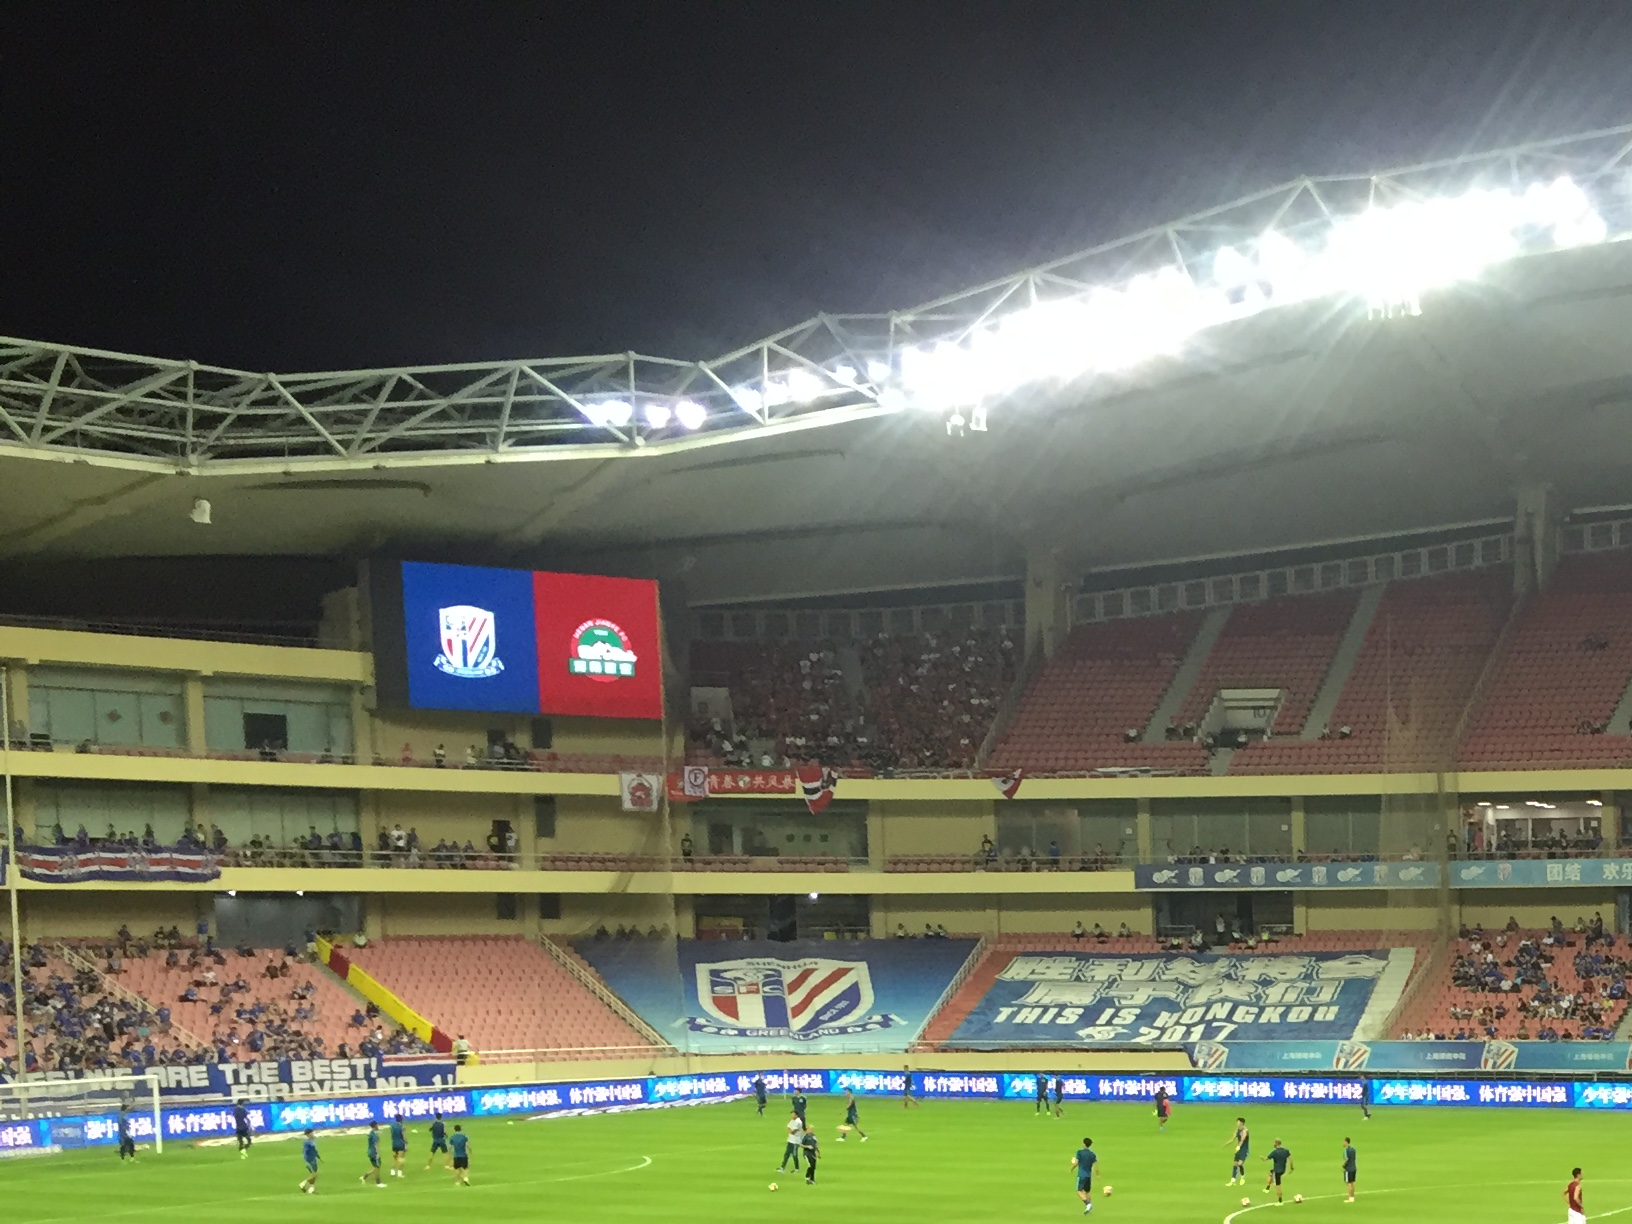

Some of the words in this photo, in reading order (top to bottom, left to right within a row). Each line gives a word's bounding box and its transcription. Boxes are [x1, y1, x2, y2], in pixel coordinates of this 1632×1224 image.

[1547, 863, 1581, 881] 团结
[993, 1007, 1084, 1025] THIS
[1096, 1007, 1141, 1025] IS
[1153, 1002, 1339, 1027] HONGKOU
[746, 1028, 840, 1041] GREENLAND
[1132, 1022, 1238, 1044] 2017
[145, 1065, 209, 1088] ARE
[218, 1062, 279, 1084] THE
[291, 1057, 378, 1082] BEST!
